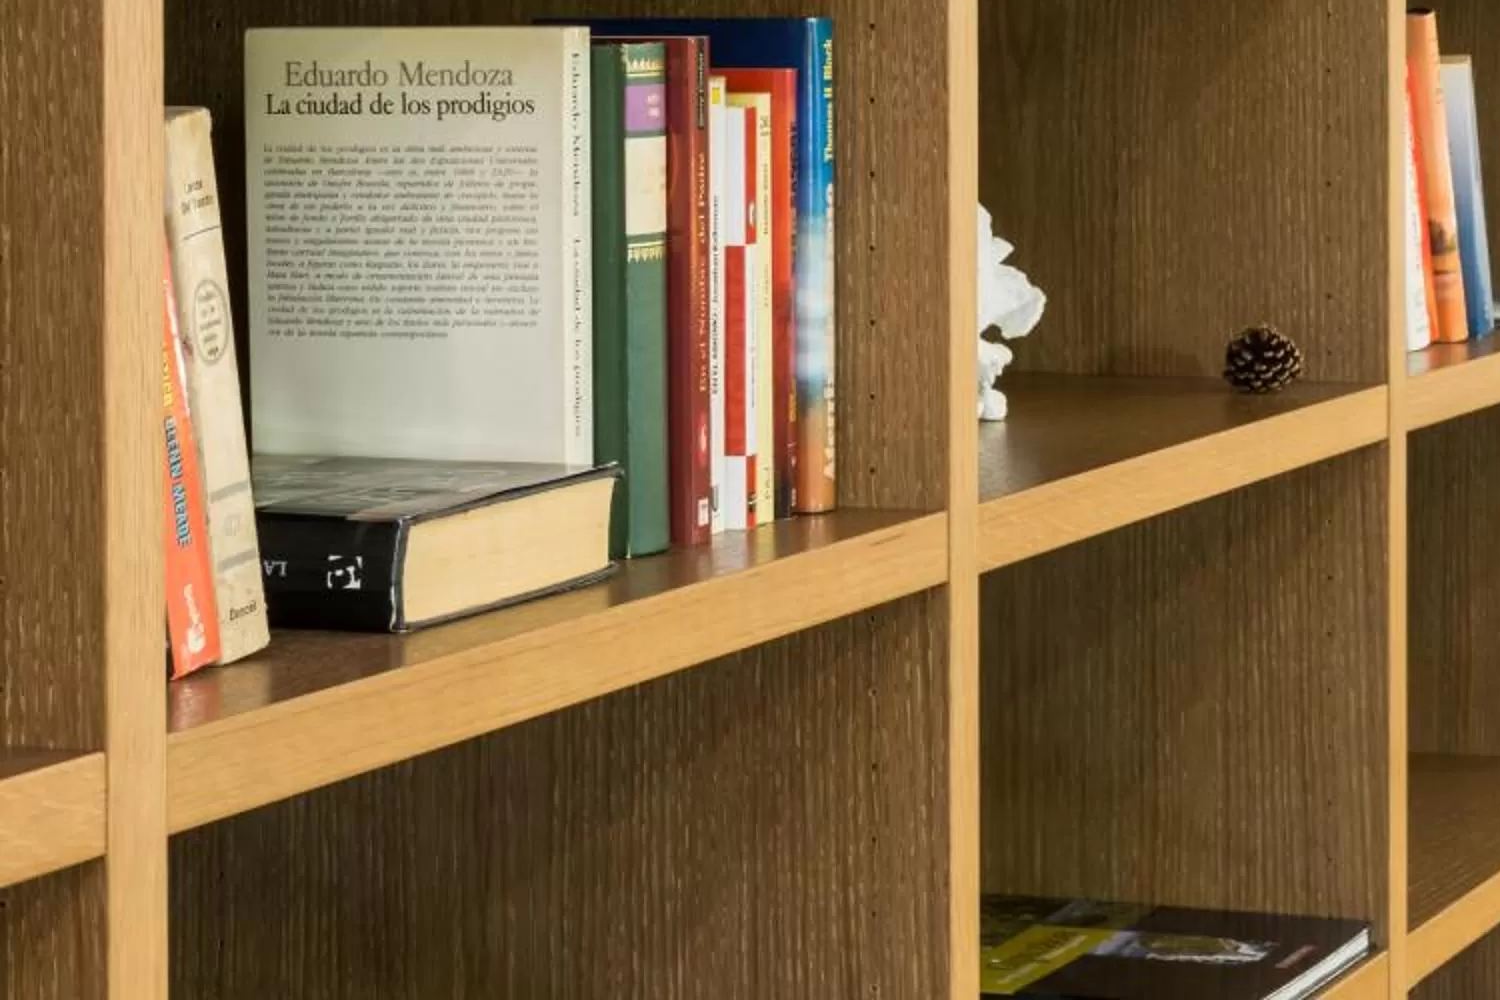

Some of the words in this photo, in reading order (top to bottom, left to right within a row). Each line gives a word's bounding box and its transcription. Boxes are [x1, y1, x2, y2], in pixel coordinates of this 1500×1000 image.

[285, 60, 388, 88] Eduardo
[400, 61, 513, 88] Mendoza
[264, 94, 292, 116] La
[296, 93, 362, 116] ciudad
[369, 92, 395, 116] de
[401, 91, 431, 115] los
[437, 92, 535, 121] prodigios
[164, 416, 183, 479] GLENN
[172, 480, 193, 548] MEADE
